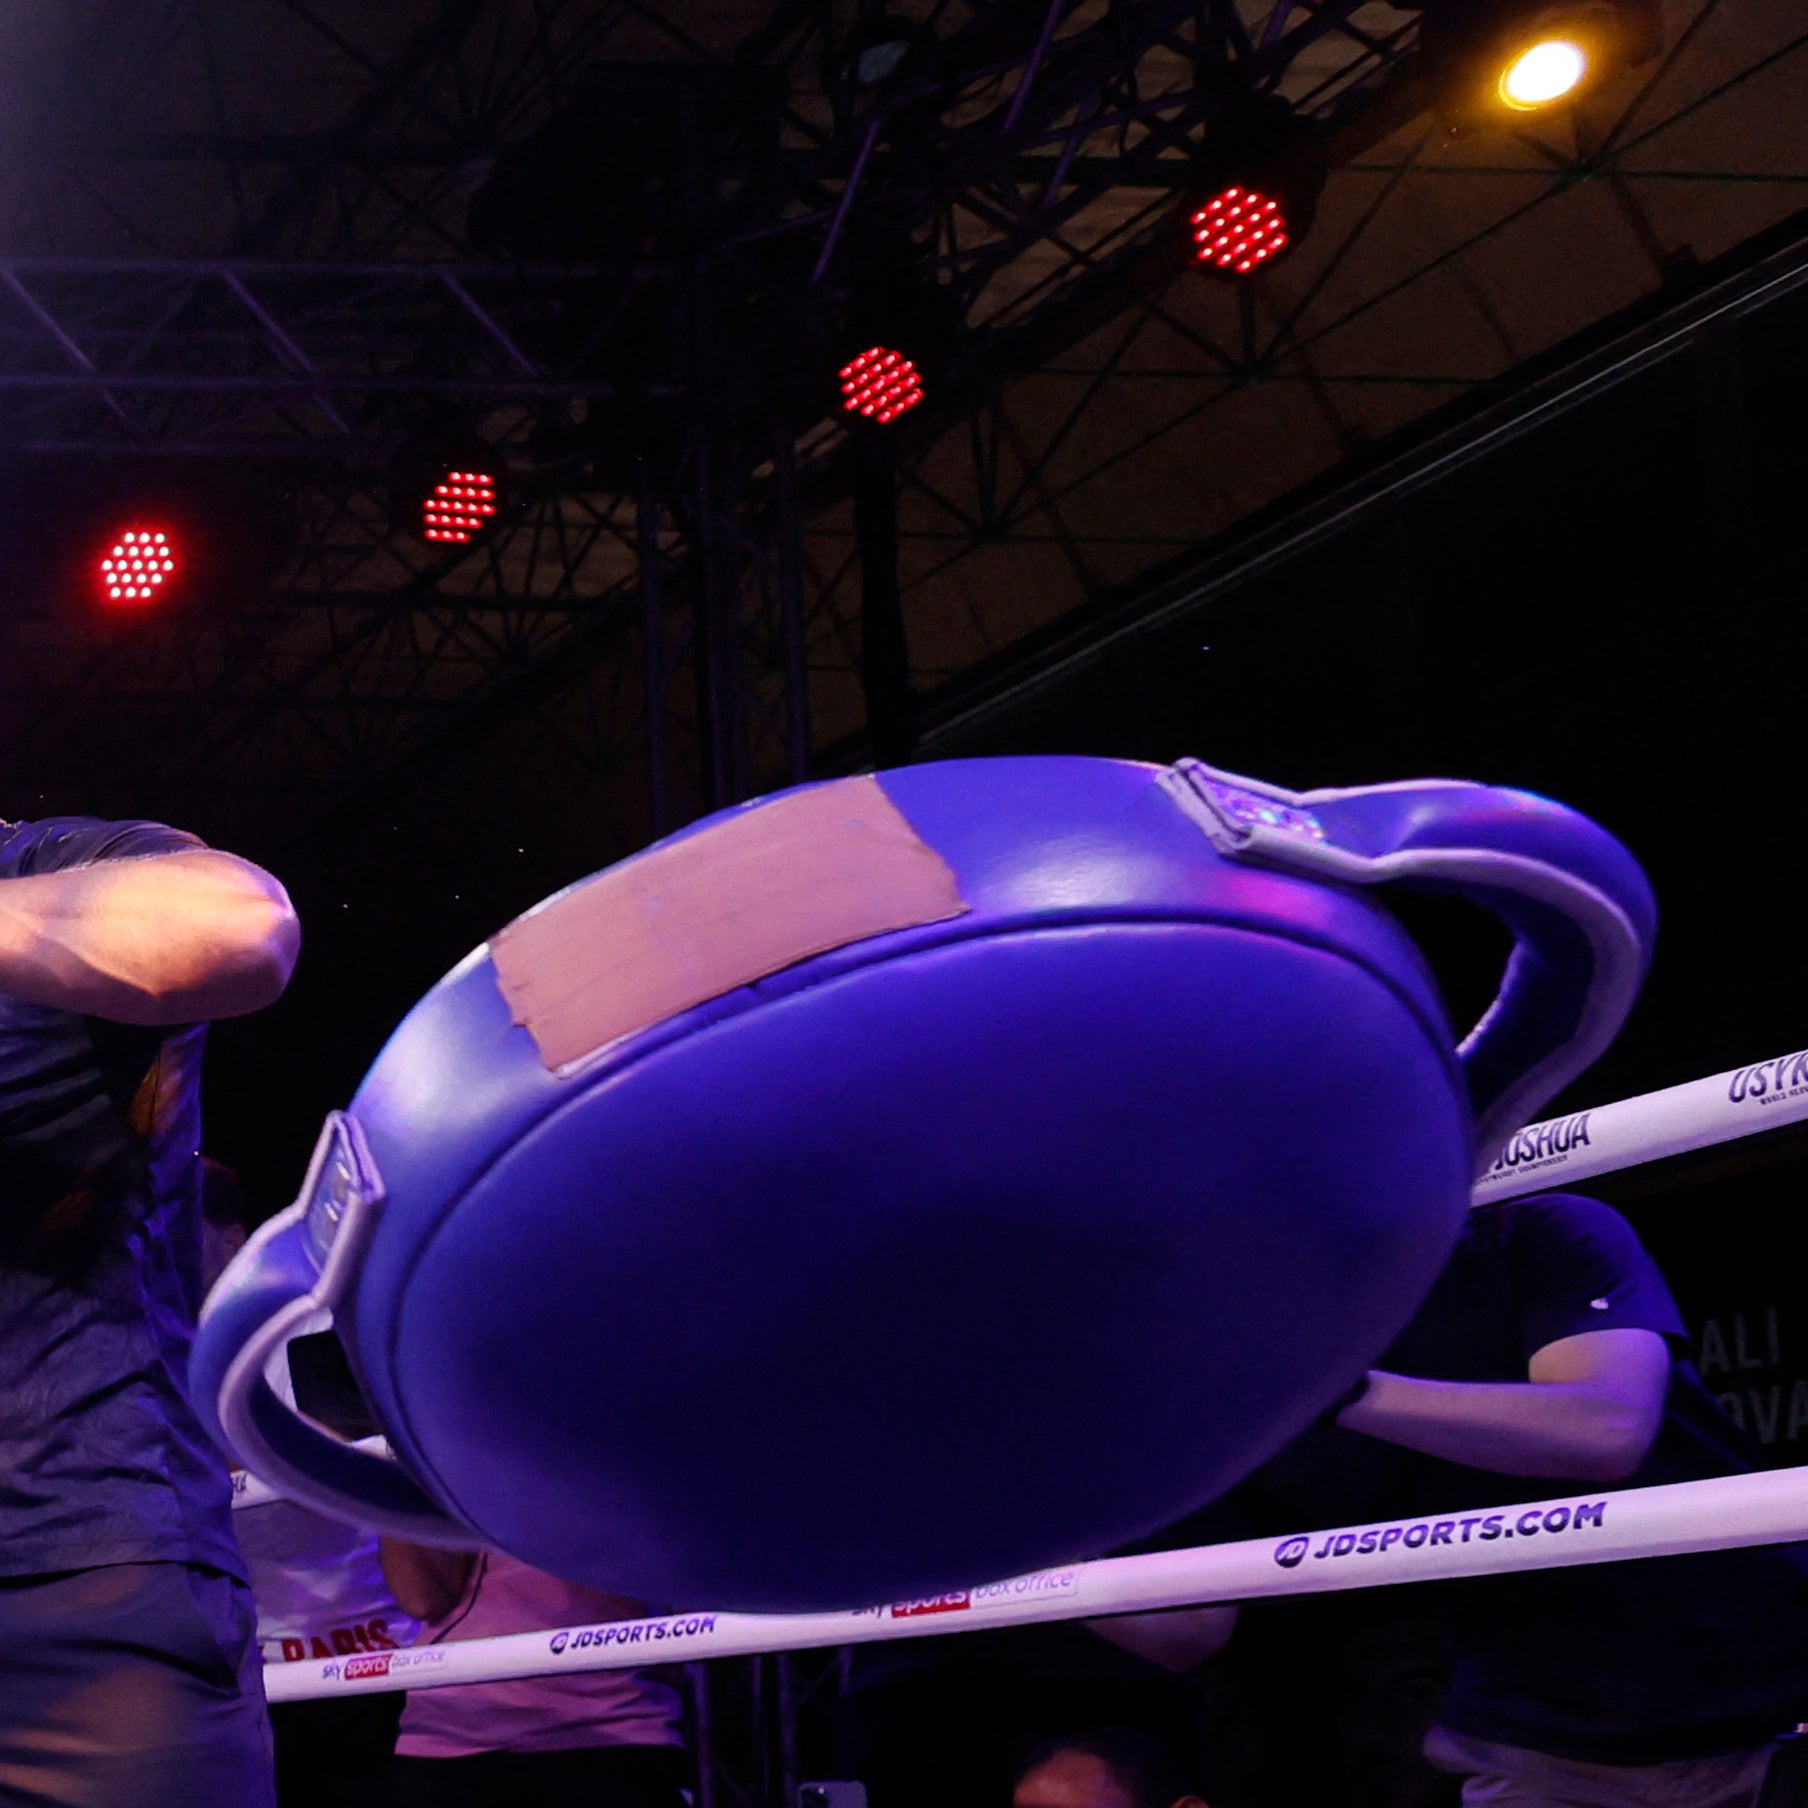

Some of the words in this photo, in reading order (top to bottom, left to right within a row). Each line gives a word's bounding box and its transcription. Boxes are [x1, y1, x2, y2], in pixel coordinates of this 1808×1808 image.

[1313, 1501, 1608, 1561] JDSPORTS.COM
[1014, 1572, 1075, 1594] office
[570, 1615, 716, 1649] JDSPORTS.COM
[323, 1663, 342, 1681] sky
[345, 1656, 390, 1676] sports
